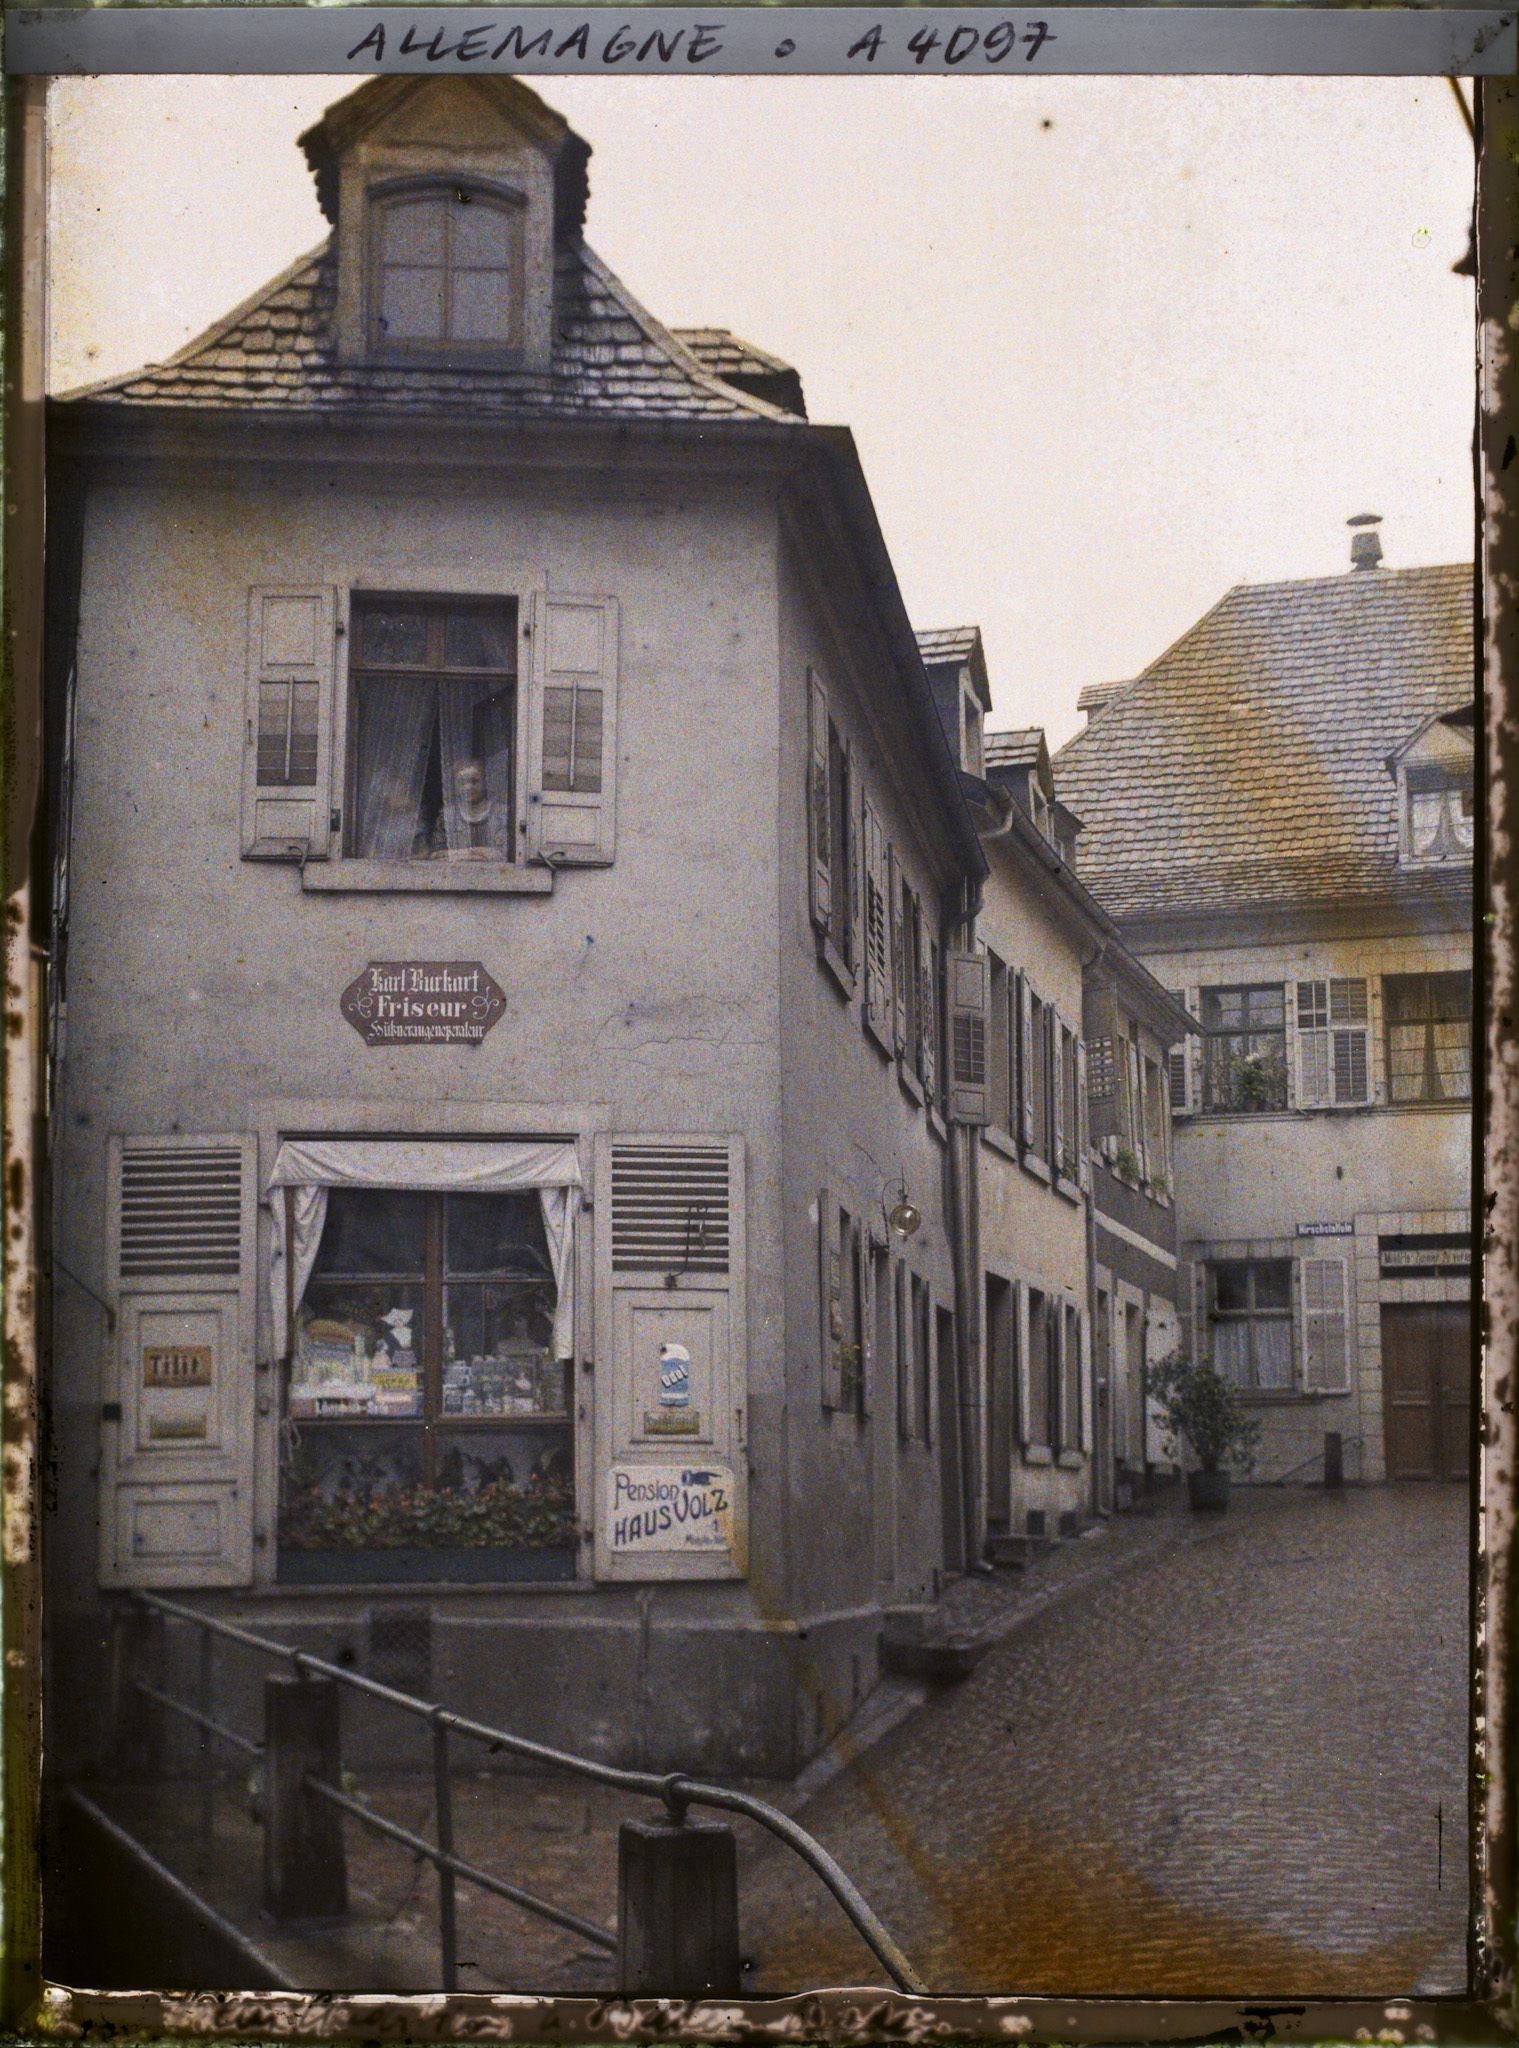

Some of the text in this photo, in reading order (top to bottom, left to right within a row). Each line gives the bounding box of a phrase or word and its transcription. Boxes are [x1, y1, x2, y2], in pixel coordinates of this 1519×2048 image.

[347, 21, 1059, 64] ALLEMAGNE A 4097
[369, 967, 406, 996] Karl
[376, 995, 468, 1018] Friseur
[660, 1364, 689, 1388] Odol
[614, 1472, 680, 1510] Pension
[614, 1488, 728, 1546] HAUS VOLZ
